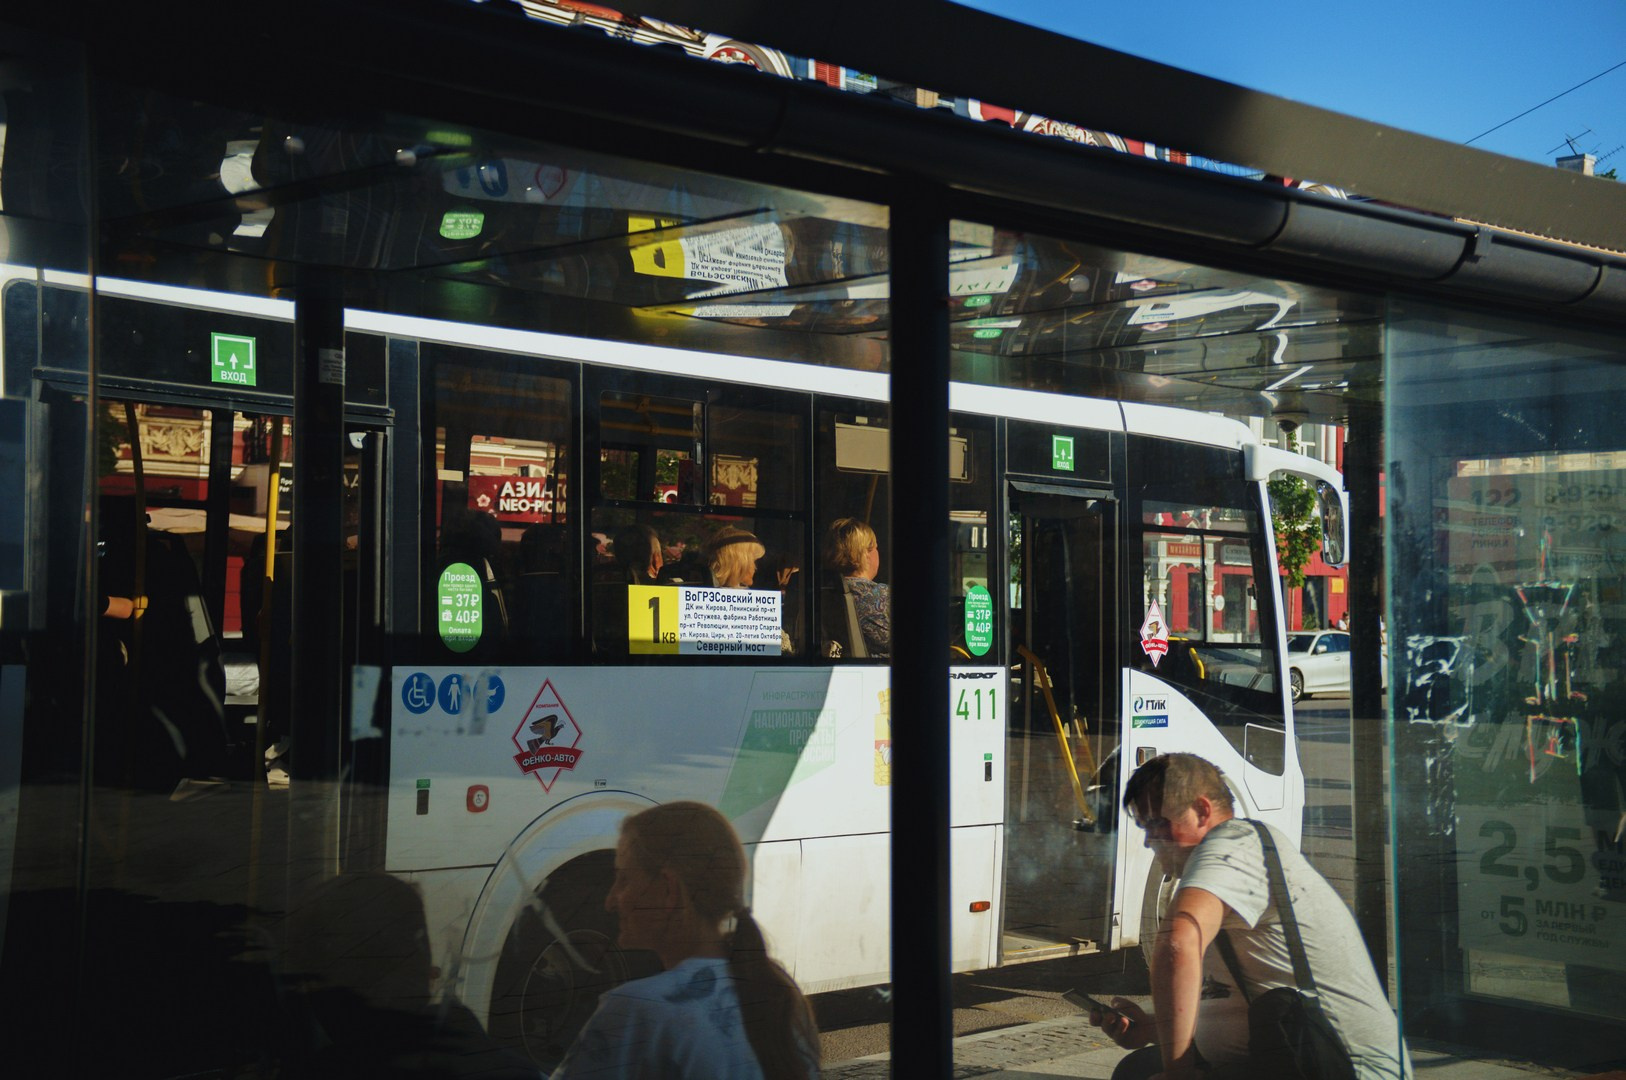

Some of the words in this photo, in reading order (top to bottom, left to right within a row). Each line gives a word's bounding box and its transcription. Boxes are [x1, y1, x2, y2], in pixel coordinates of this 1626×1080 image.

[221, 370, 247, 383] ВХОД
[444, 572, 476, 584] Проезд
[685, 590, 753, 605] ВоГРЭСовский
[755, 595, 776, 606] мост
[968, 592, 988, 601] Проезд
[685, 603, 695, 612] ДК
[705, 603, 728, 613] Кирова,
[729, 604, 760, 613] Ленинский
[761, 606, 776, 615] пр-кт
[683, 613, 692, 622] ул.
[693, 612, 722, 622] Остужева,
[723, 613, 747, 623] фабрика
[748, 614, 778, 624] Работница
[679, 622, 696, 631] пр-кт
[697, 621, 730, 631] Революции,
[731, 623, 758, 632] кинотеатр
[759, 623, 782, 632] Спартак
[679, 632, 688, 640] ул.
[736, 632, 760, 641] 20-летия
[696, 640, 743, 655] Северный
[745, 644, 766, 655] мост
[956, 688, 996, 721] 411
[1146, 699, 1167, 711] ГТЛК
[754, 711, 835, 730] НАЦИОНАЛЬНЫЕ
[789, 728, 835, 745] ПРОЕКТЫ
[522, 753, 576, 767] ФЕНКО-АВТО
[1478, 820, 1586, 891] 2,5
[1498, 894, 1528, 938] 5
[1535, 898, 1587, 922] МЛН
[1535, 919, 1551, 930] ЗА
[1536, 930, 1560, 944] ГОД
